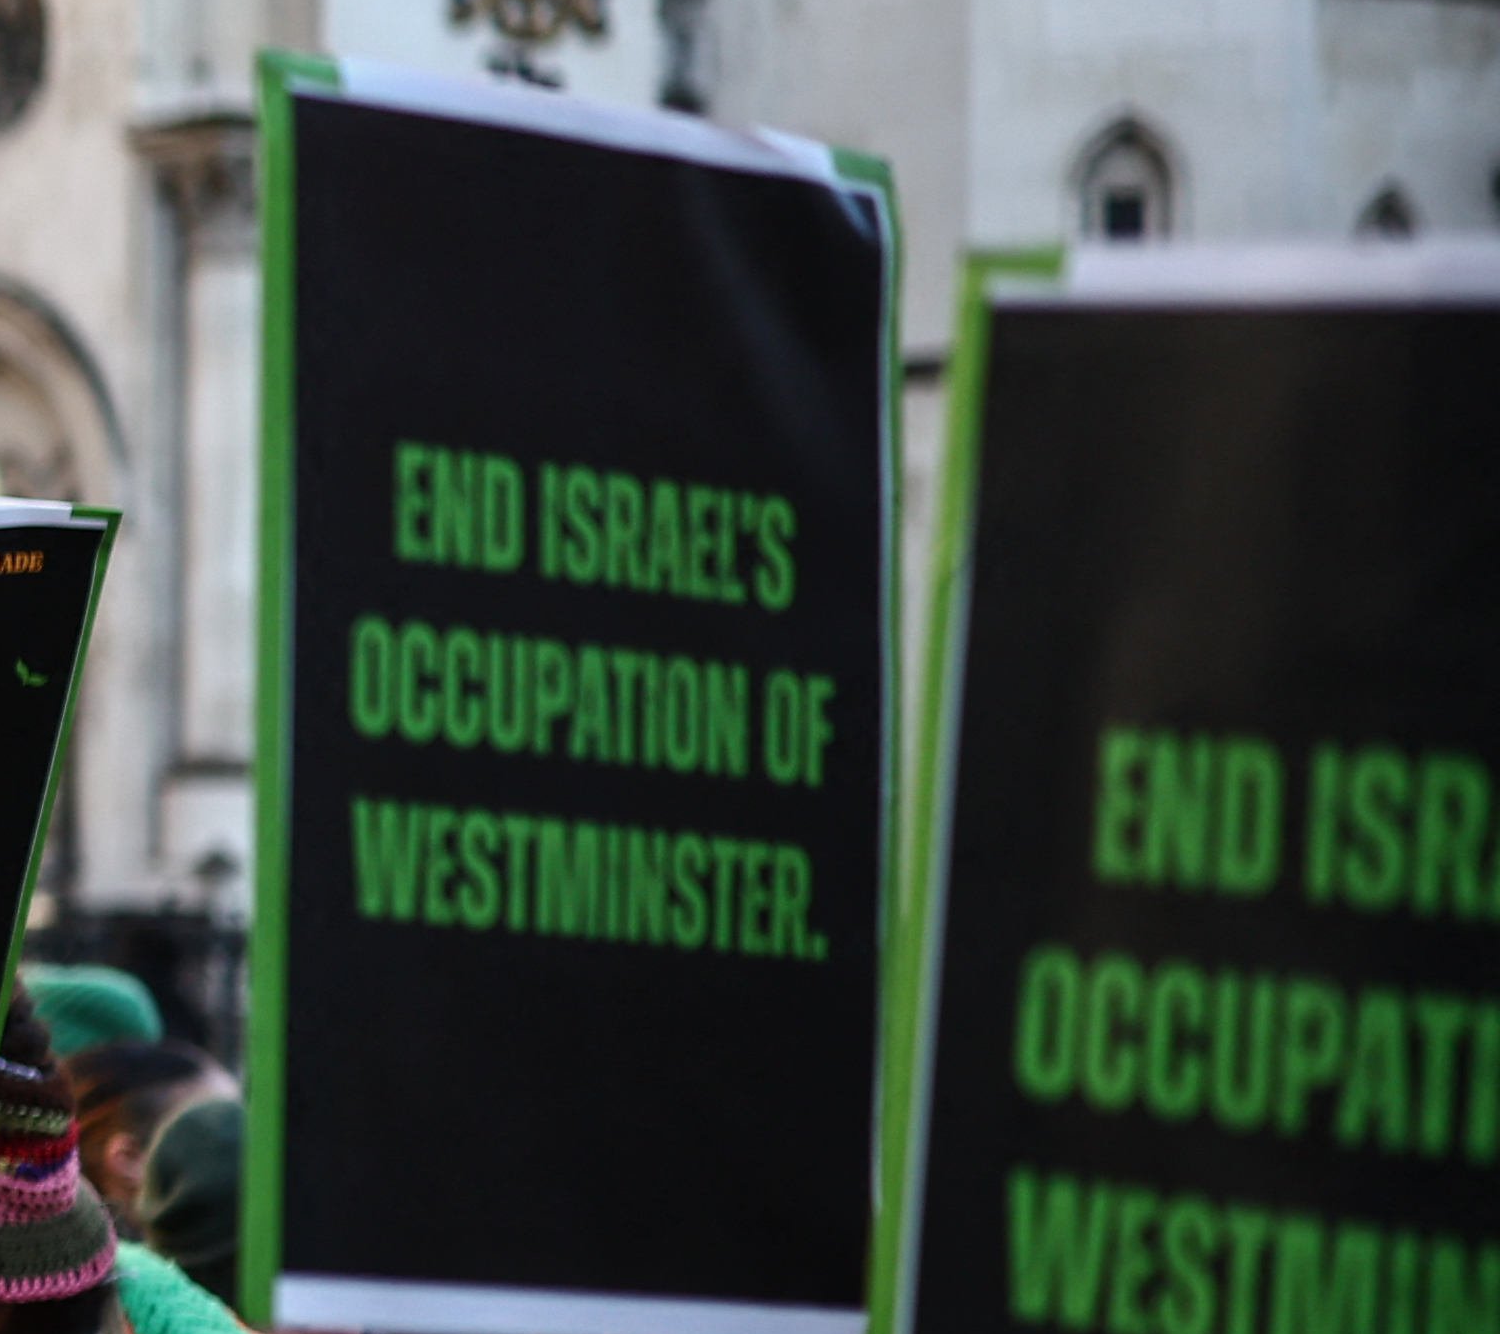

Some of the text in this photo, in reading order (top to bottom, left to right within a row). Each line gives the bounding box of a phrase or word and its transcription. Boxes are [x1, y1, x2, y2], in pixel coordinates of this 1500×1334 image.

[394, 441, 797, 611] END ISRAEL'S
[349, 613, 837, 788] OCCUPATION OF
[351, 795, 831, 961] WESTMINSTER.
[1094, 725, 1500, 927] END ISR
